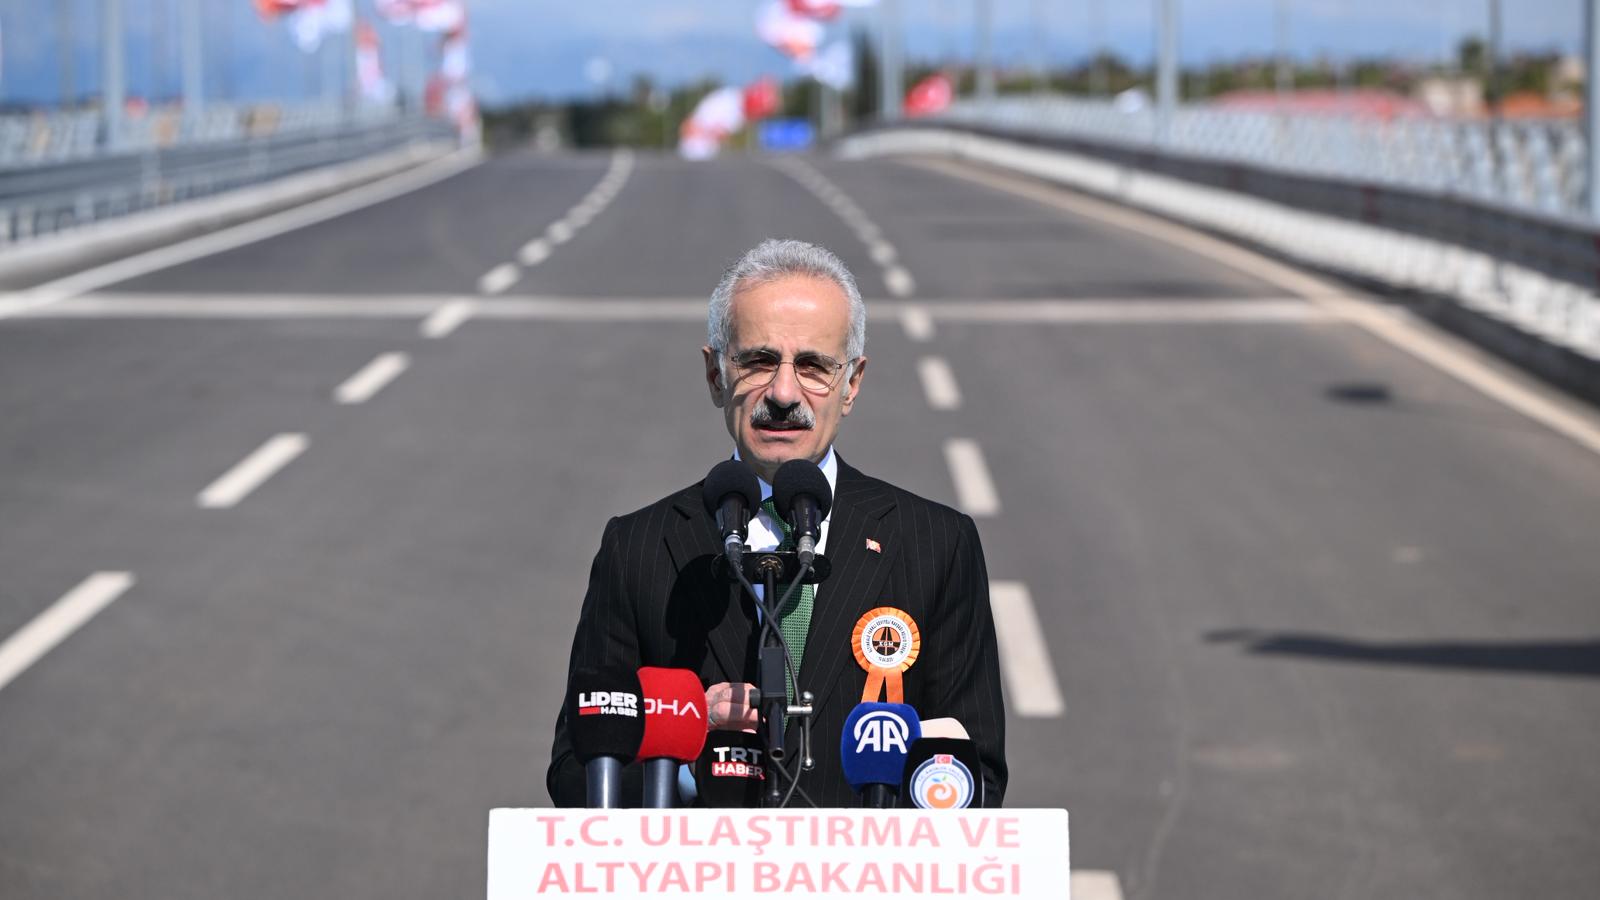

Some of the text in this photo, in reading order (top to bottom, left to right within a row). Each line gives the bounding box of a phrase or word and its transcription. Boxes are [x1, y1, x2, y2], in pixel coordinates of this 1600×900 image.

[600, 706, 638, 717] HABER
[643, 698, 701, 719] DHA
[856, 720, 907, 753] AA
[713, 746, 762, 765] TRT
[714, 763, 765, 780] HABER
[536, 815, 1021, 856] T.C. ULAŞTIRMA VE
[536, 857, 1021, 894] ALTYAPI BAKANLIĞI
